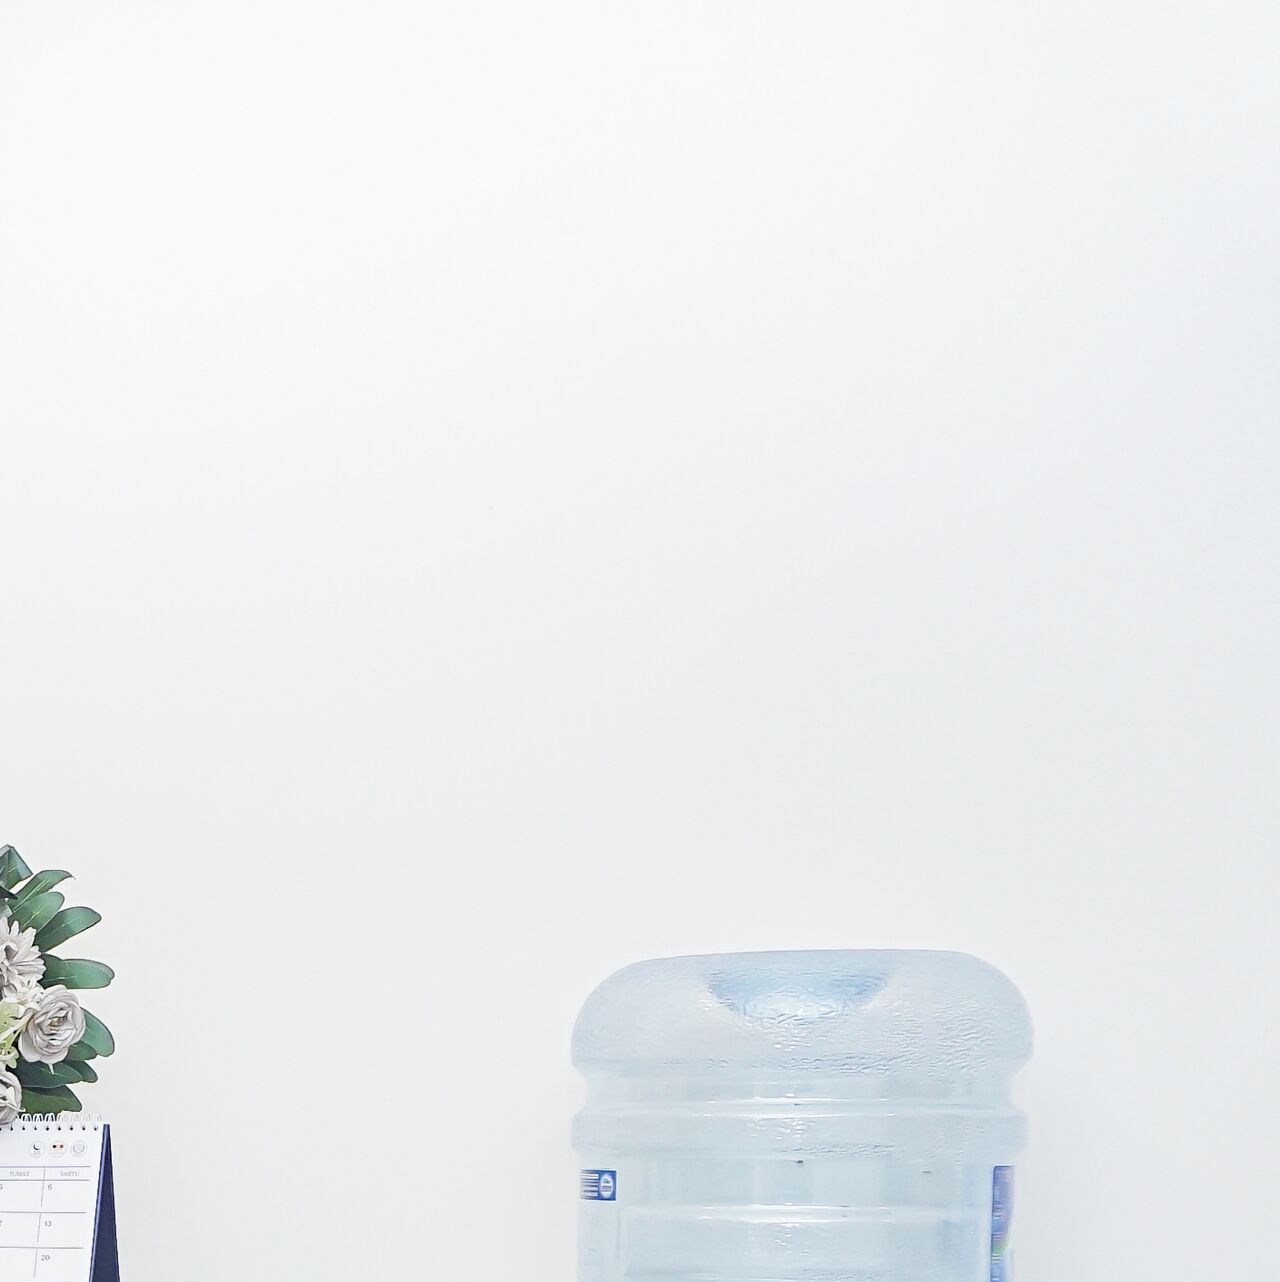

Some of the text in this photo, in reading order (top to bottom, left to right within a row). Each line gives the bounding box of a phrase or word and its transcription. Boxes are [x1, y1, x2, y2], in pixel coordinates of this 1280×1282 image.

[47, 1183, 53, 1191] 6
[44, 1220, 52, 1228] 13
[40, 1254, 51, 1262] 20
